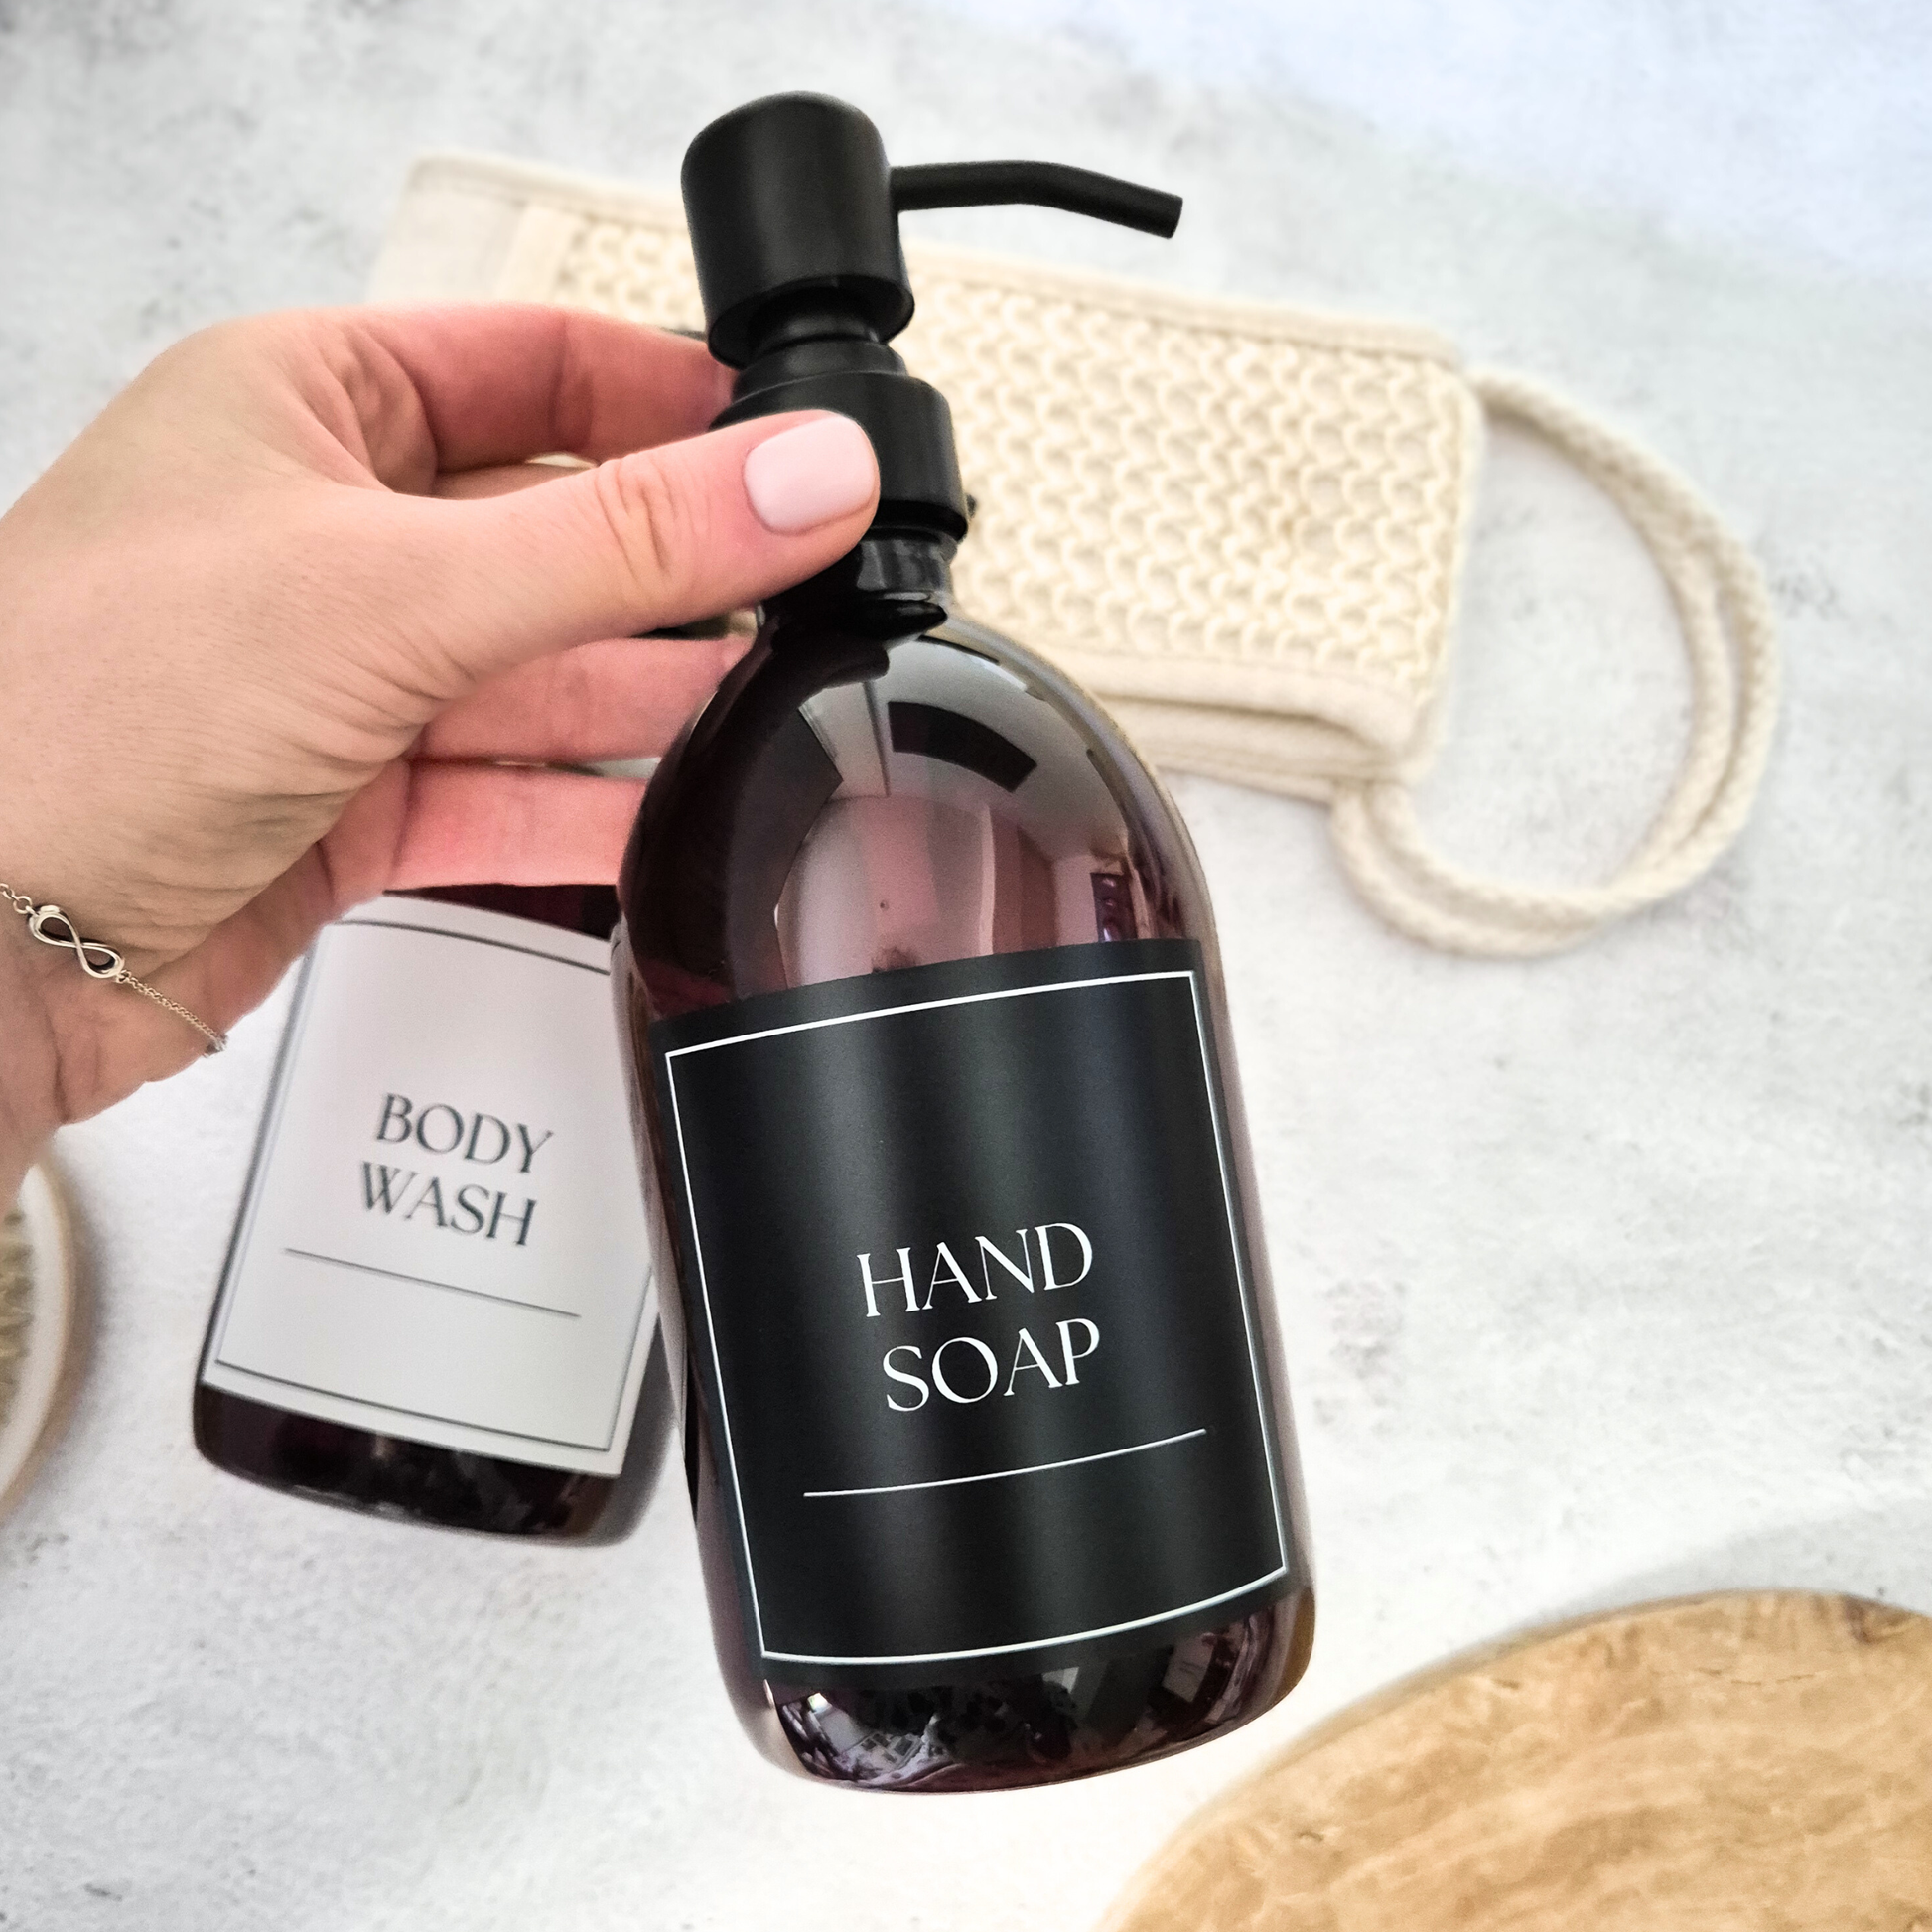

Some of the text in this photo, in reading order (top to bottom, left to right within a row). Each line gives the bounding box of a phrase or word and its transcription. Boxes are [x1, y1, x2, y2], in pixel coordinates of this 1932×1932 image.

[374, 1091, 554, 1174] BODY
[359, 1160, 538, 1248] WASH
[855, 1221, 1094, 1319] HAND
[881, 1316, 1101, 1413] SOAP
